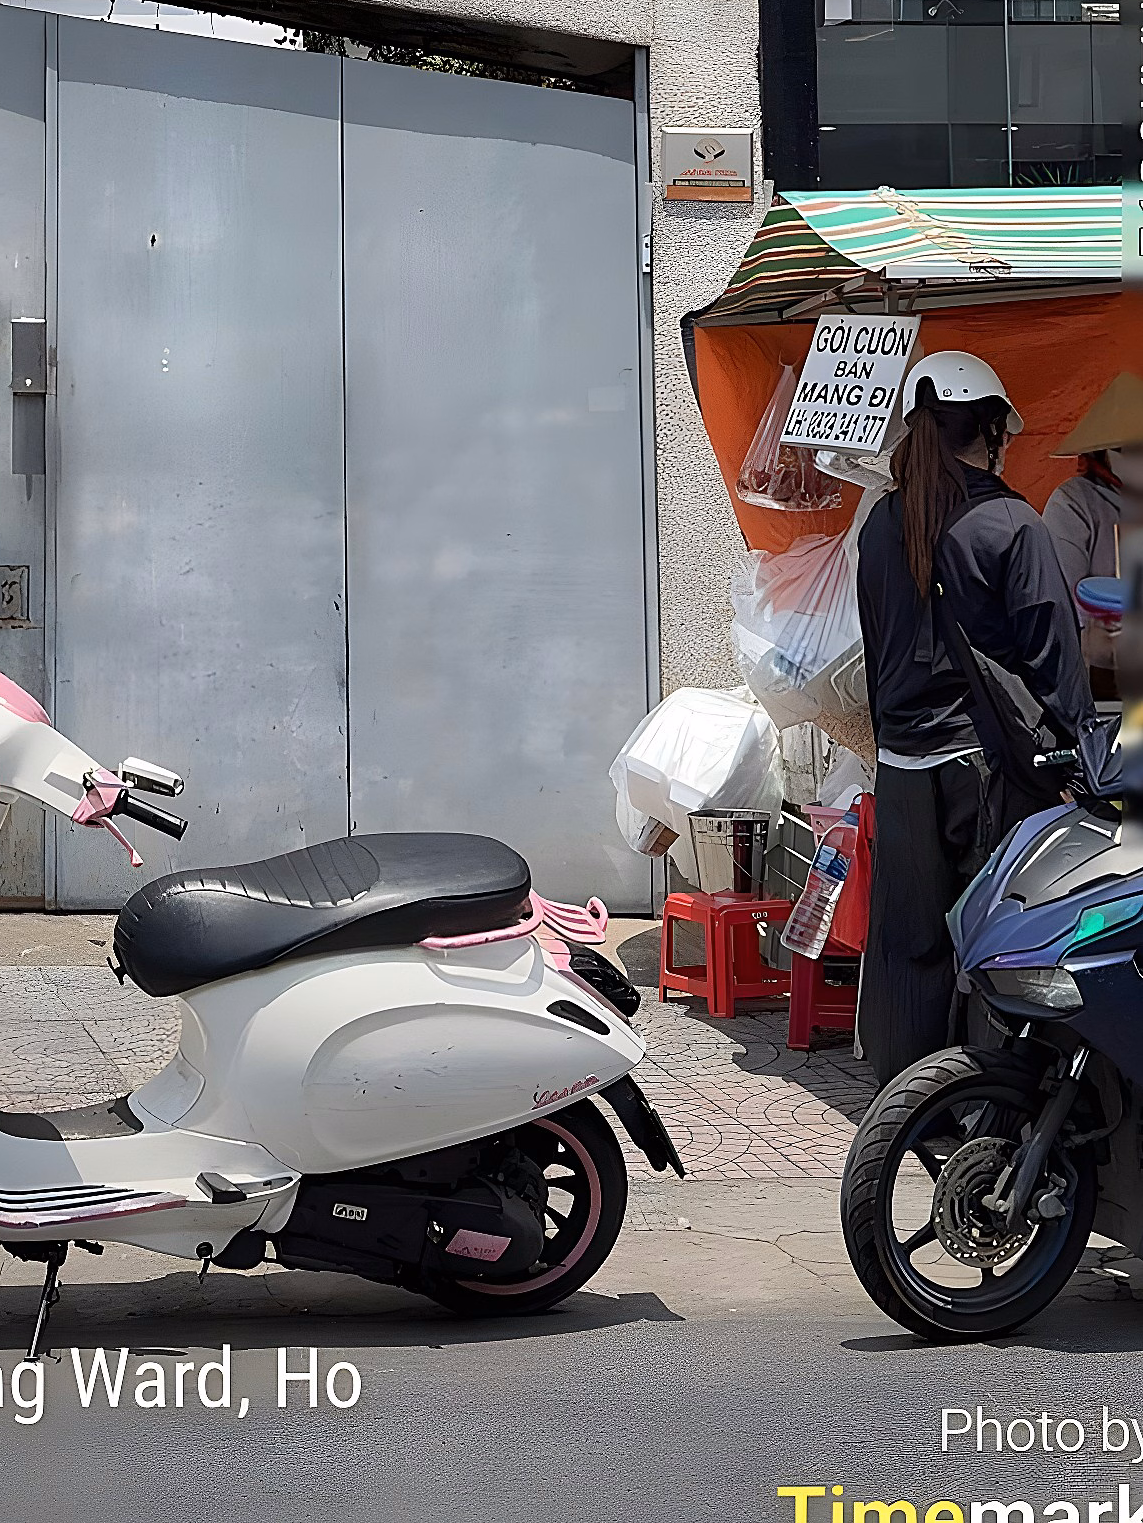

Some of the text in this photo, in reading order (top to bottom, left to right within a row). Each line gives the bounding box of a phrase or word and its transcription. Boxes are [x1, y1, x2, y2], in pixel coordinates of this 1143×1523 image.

[833, 356, 874, 380] BÁN
[796, 381, 896, 409] MANG ĐI
